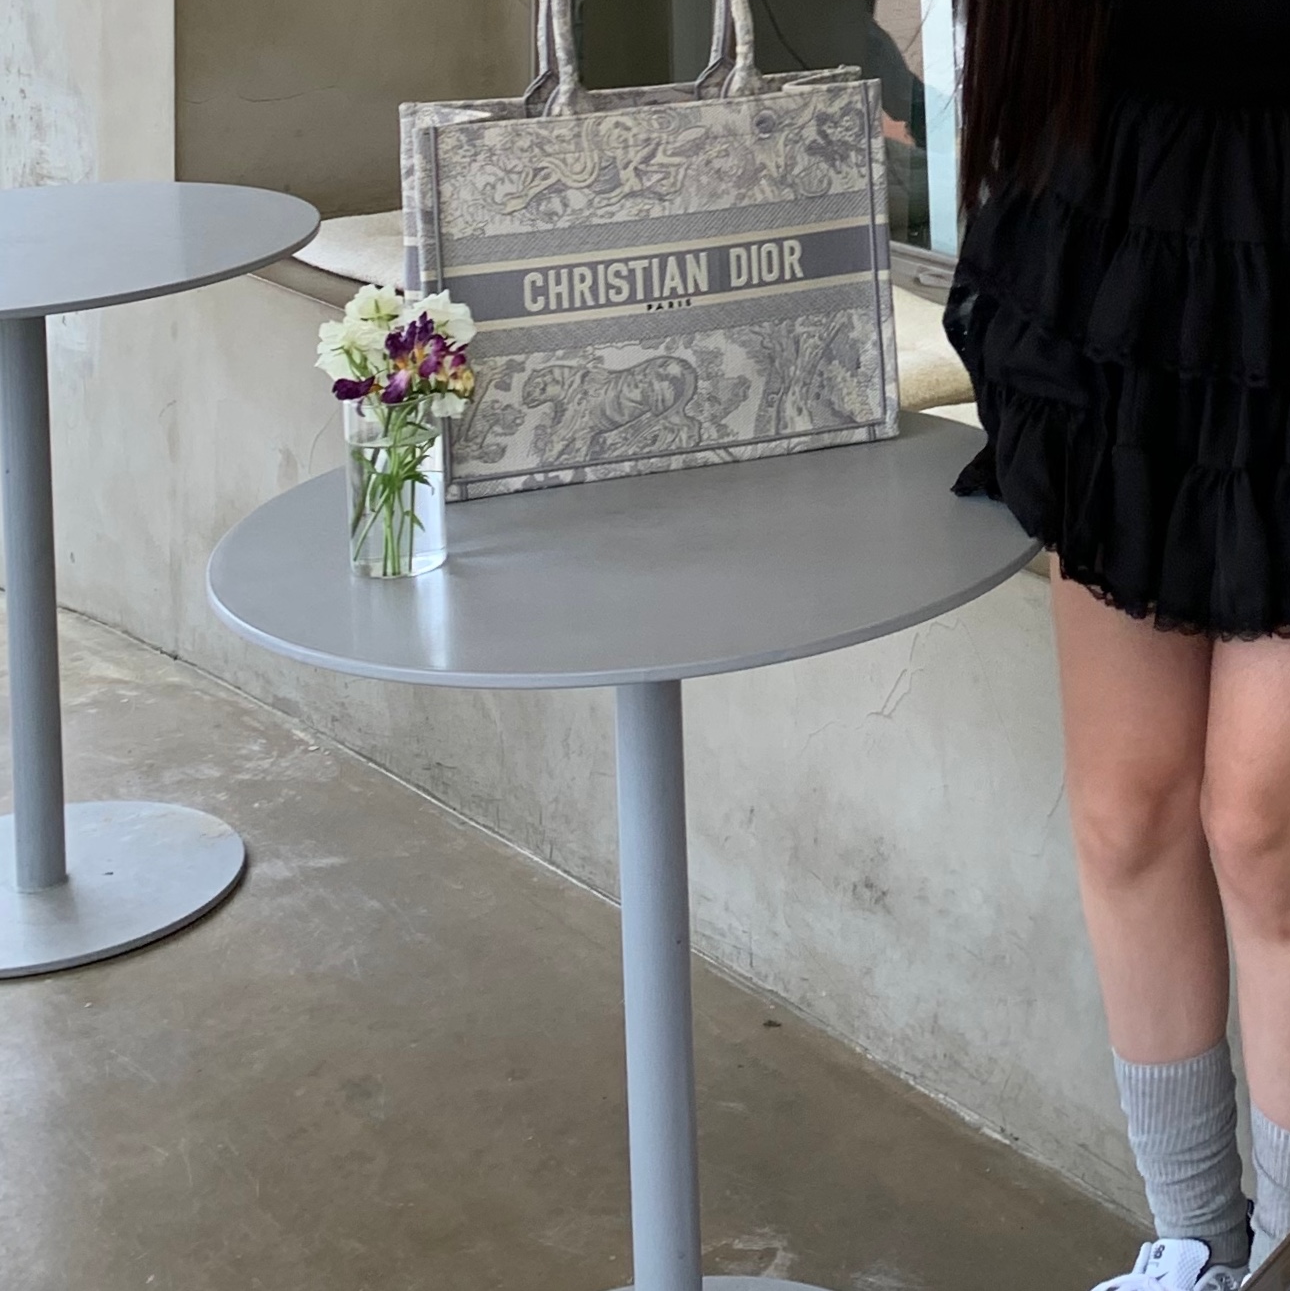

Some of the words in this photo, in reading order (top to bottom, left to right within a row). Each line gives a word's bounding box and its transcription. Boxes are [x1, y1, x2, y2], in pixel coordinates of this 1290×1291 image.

[523, 252, 709, 312] CHRISTIAN
[729, 239, 804, 288] DIOR
[646, 298, 691, 311] PARIS
